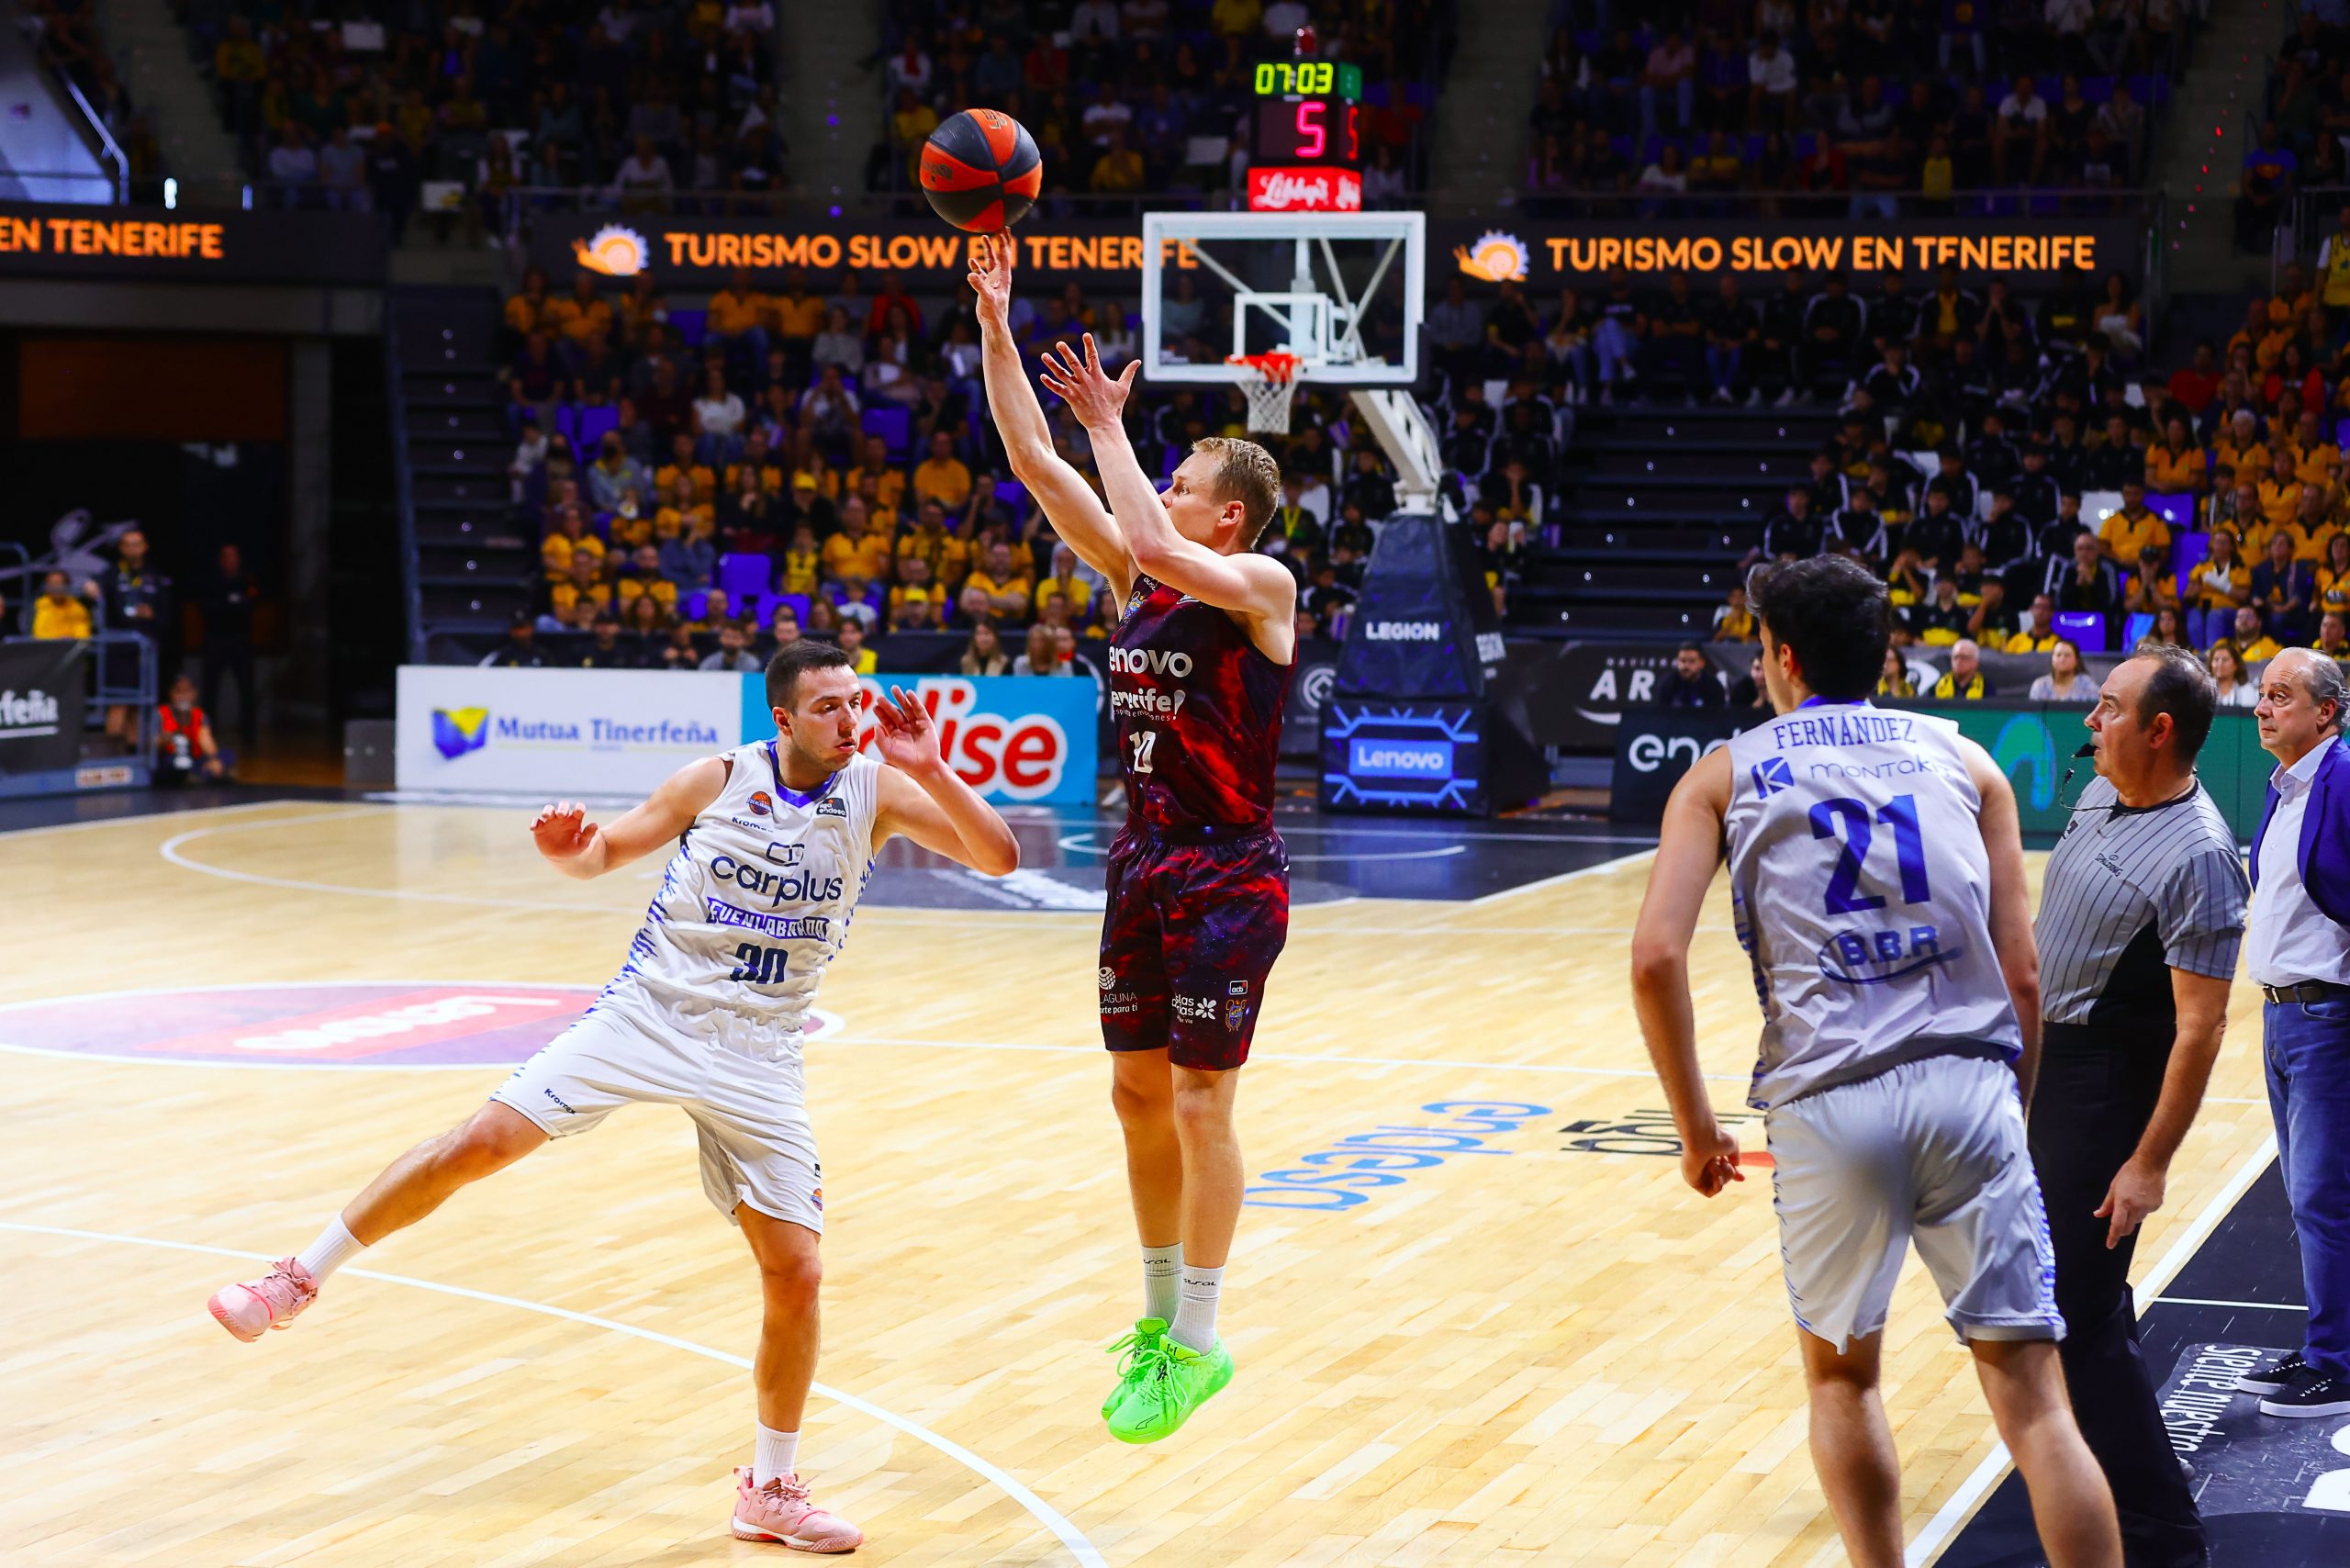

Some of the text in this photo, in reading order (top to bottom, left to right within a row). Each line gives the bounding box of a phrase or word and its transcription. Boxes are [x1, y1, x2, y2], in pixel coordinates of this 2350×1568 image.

[1255, 63, 1334, 95] 07:03
[1295, 102, 1326, 157] 5
[0, 217, 223, 258] EN TENERIFE
[664, 233, 840, 268] TURISMO
[848, 233, 959, 268] SLOW
[1024, 236, 1200, 269] TENERFE
[1546, 236, 2096, 272] TURISMO SLOW EN TENERIFE
[1366, 622, 1440, 642] LEGION
[1109, 646, 1192, 678] enovo
[1111, 688, 1186, 720] enerife!
[497, 717, 719, 745] Mutua Tinerfeña
[1773, 712, 1917, 750] FERNÁNDEZ
[1358, 745, 1444, 770] Lenovo
[1808, 794, 1930, 915] 21
[711, 856, 844, 907] carplus
[708, 899, 830, 941] FUENLABRADA
[1113, 1004, 1130, 1015] para
[1132, 1002, 1138, 1012] ti
[1243, 1101, 1553, 1211] endesa
